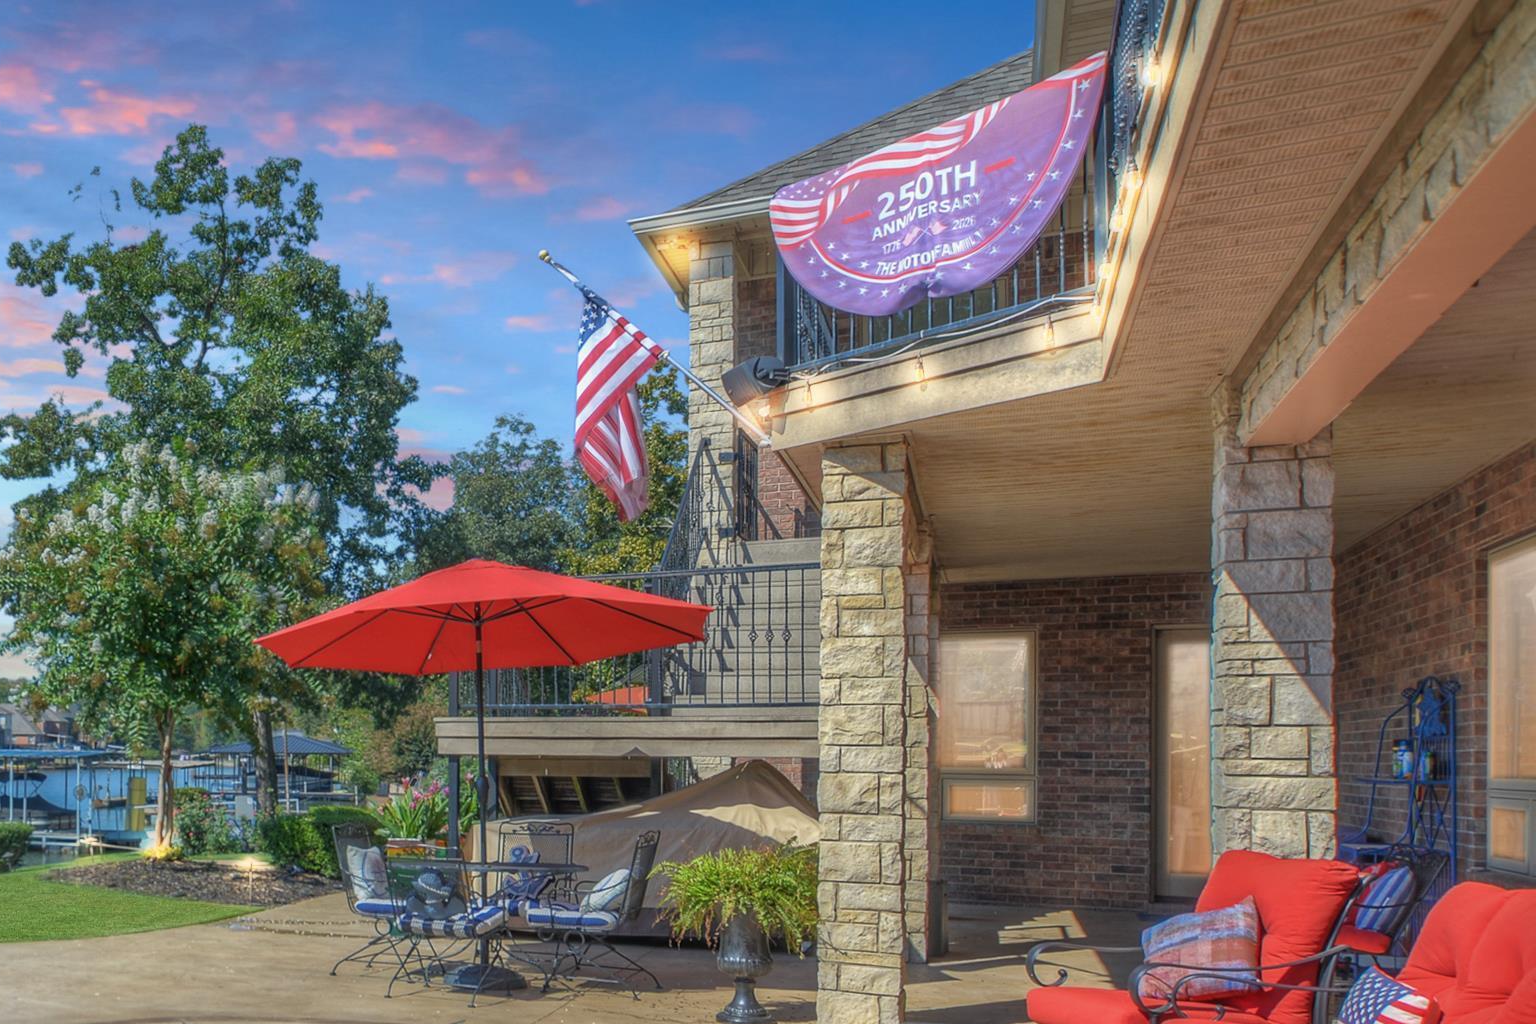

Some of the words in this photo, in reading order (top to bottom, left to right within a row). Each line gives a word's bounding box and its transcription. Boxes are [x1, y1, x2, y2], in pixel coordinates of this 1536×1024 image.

[871, 189, 983, 242] ANNIVERSARY
[877, 159, 977, 221] 250TH
[875, 261, 898, 276] THE
